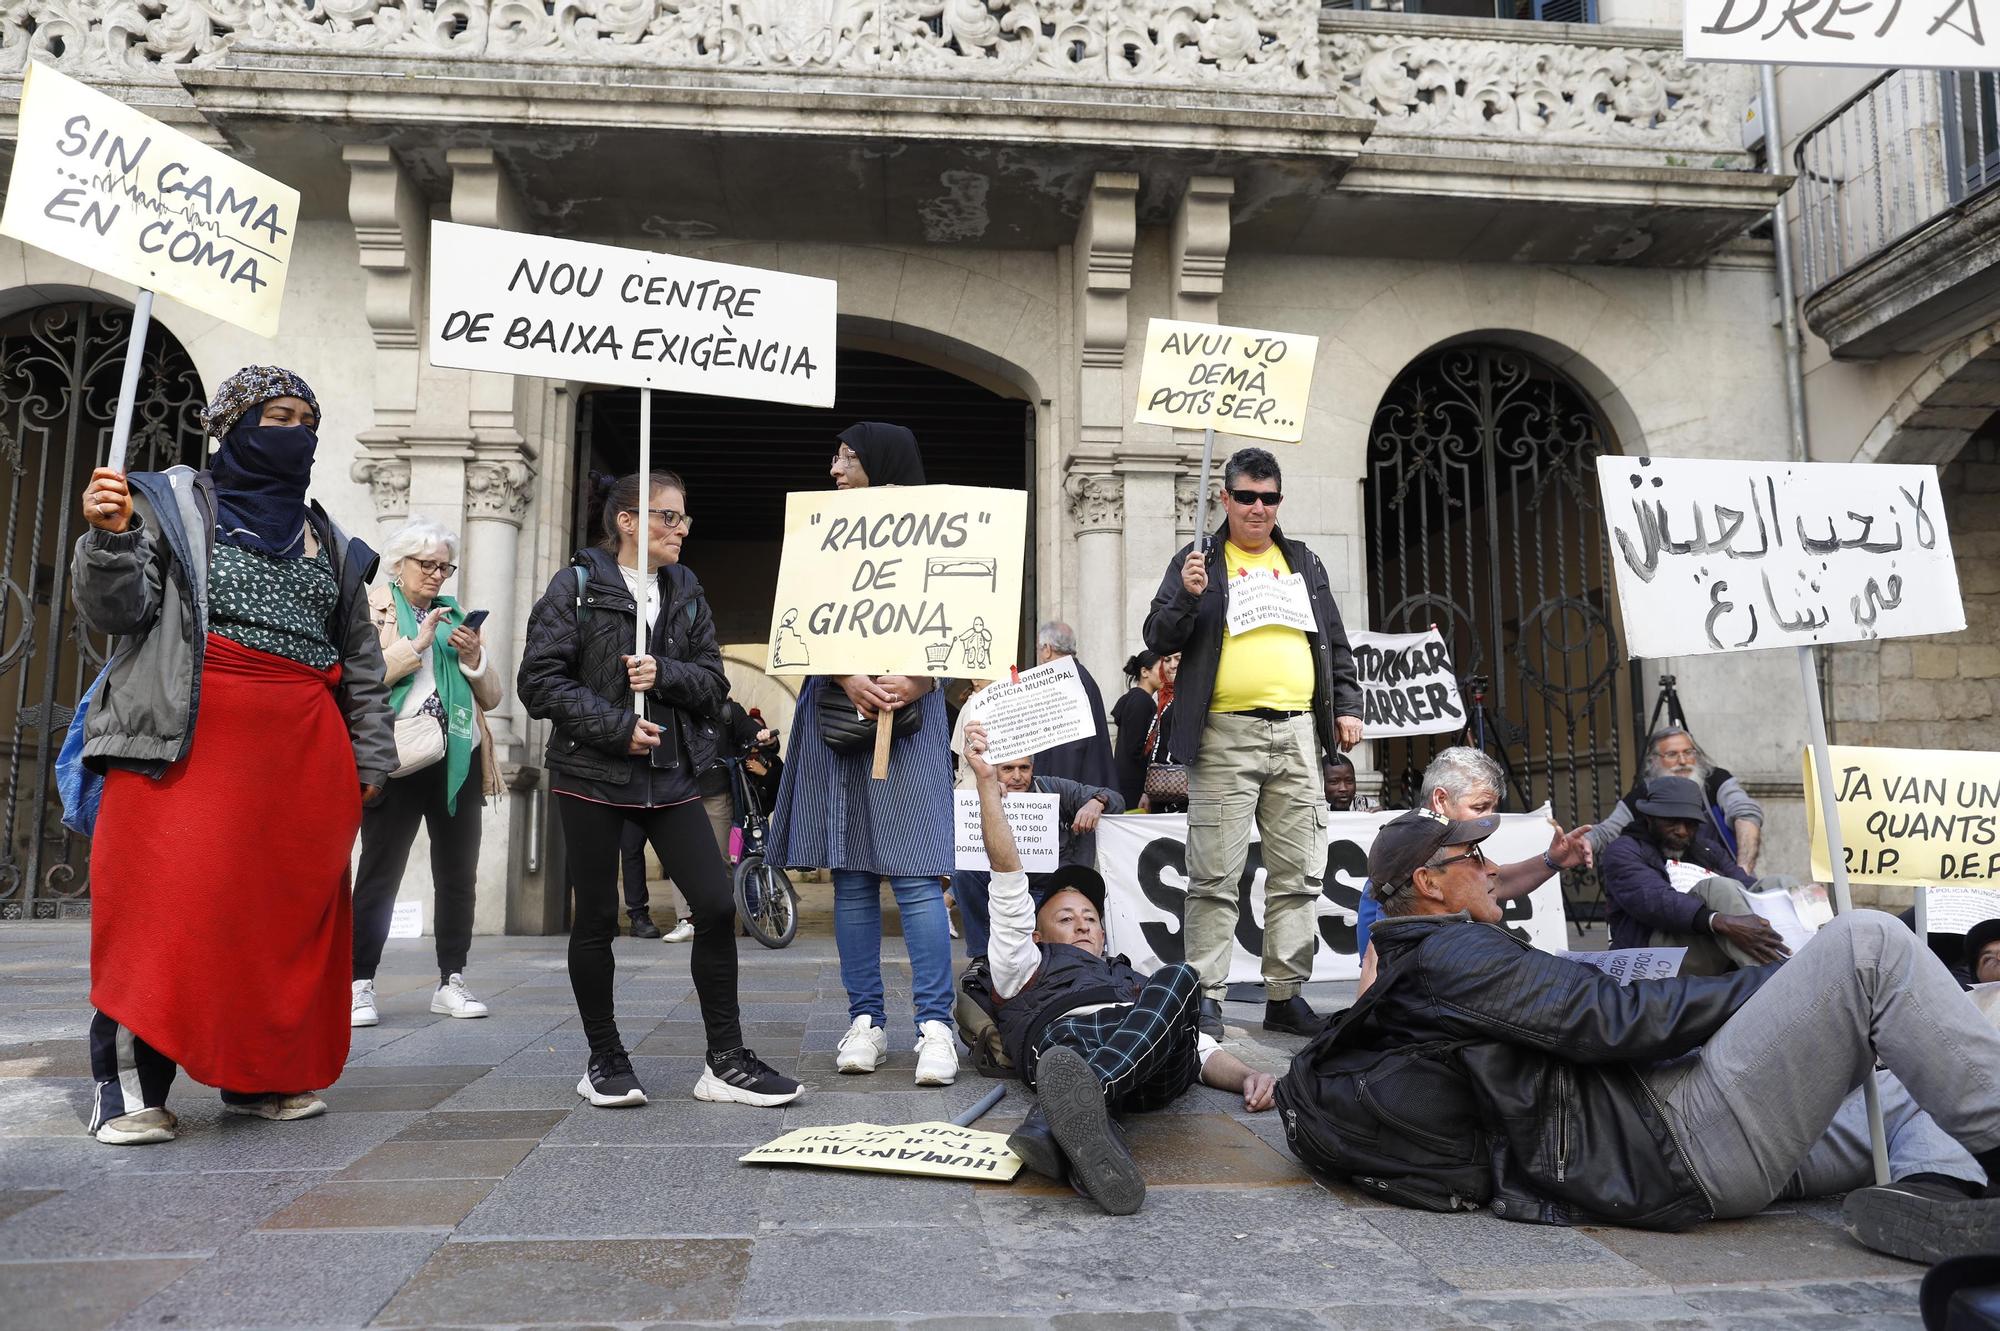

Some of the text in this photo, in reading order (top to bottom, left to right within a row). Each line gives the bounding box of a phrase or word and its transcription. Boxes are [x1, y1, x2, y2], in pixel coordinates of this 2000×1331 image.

[56, 114, 288, 244] SIN CAMA
[44, 188, 268, 293] EN COMA
[508, 258, 761, 318] NOU CENTRE
[441, 310, 817, 379] DE BAIXA EXIGÈNCIA
[1161, 332, 1288, 363] AVUI JO
[1188, 362, 1268, 396] DEMÀ
[1148, 387, 1294, 426] POTS SER...
[810, 512, 991, 551] "RACONS"
[852, 558, 902, 592] DE
[808, 598, 952, 638] GIRONA
[1240, 615, 1256, 626] ELS
[1242, 609, 1253, 618] NO
[1352, 641, 1456, 687] TORNAR
[975, 700, 985, 710] LA
[1025, 670, 1074, 691] MUNICIPAL
[1363, 683, 1462, 727] ARRER
[1835, 766, 1872, 802] JA
[1883, 776, 1947, 806] VAN
[1023, 834, 1042, 843] FRÍO!
[1866, 811, 1997, 845] QUANTS
